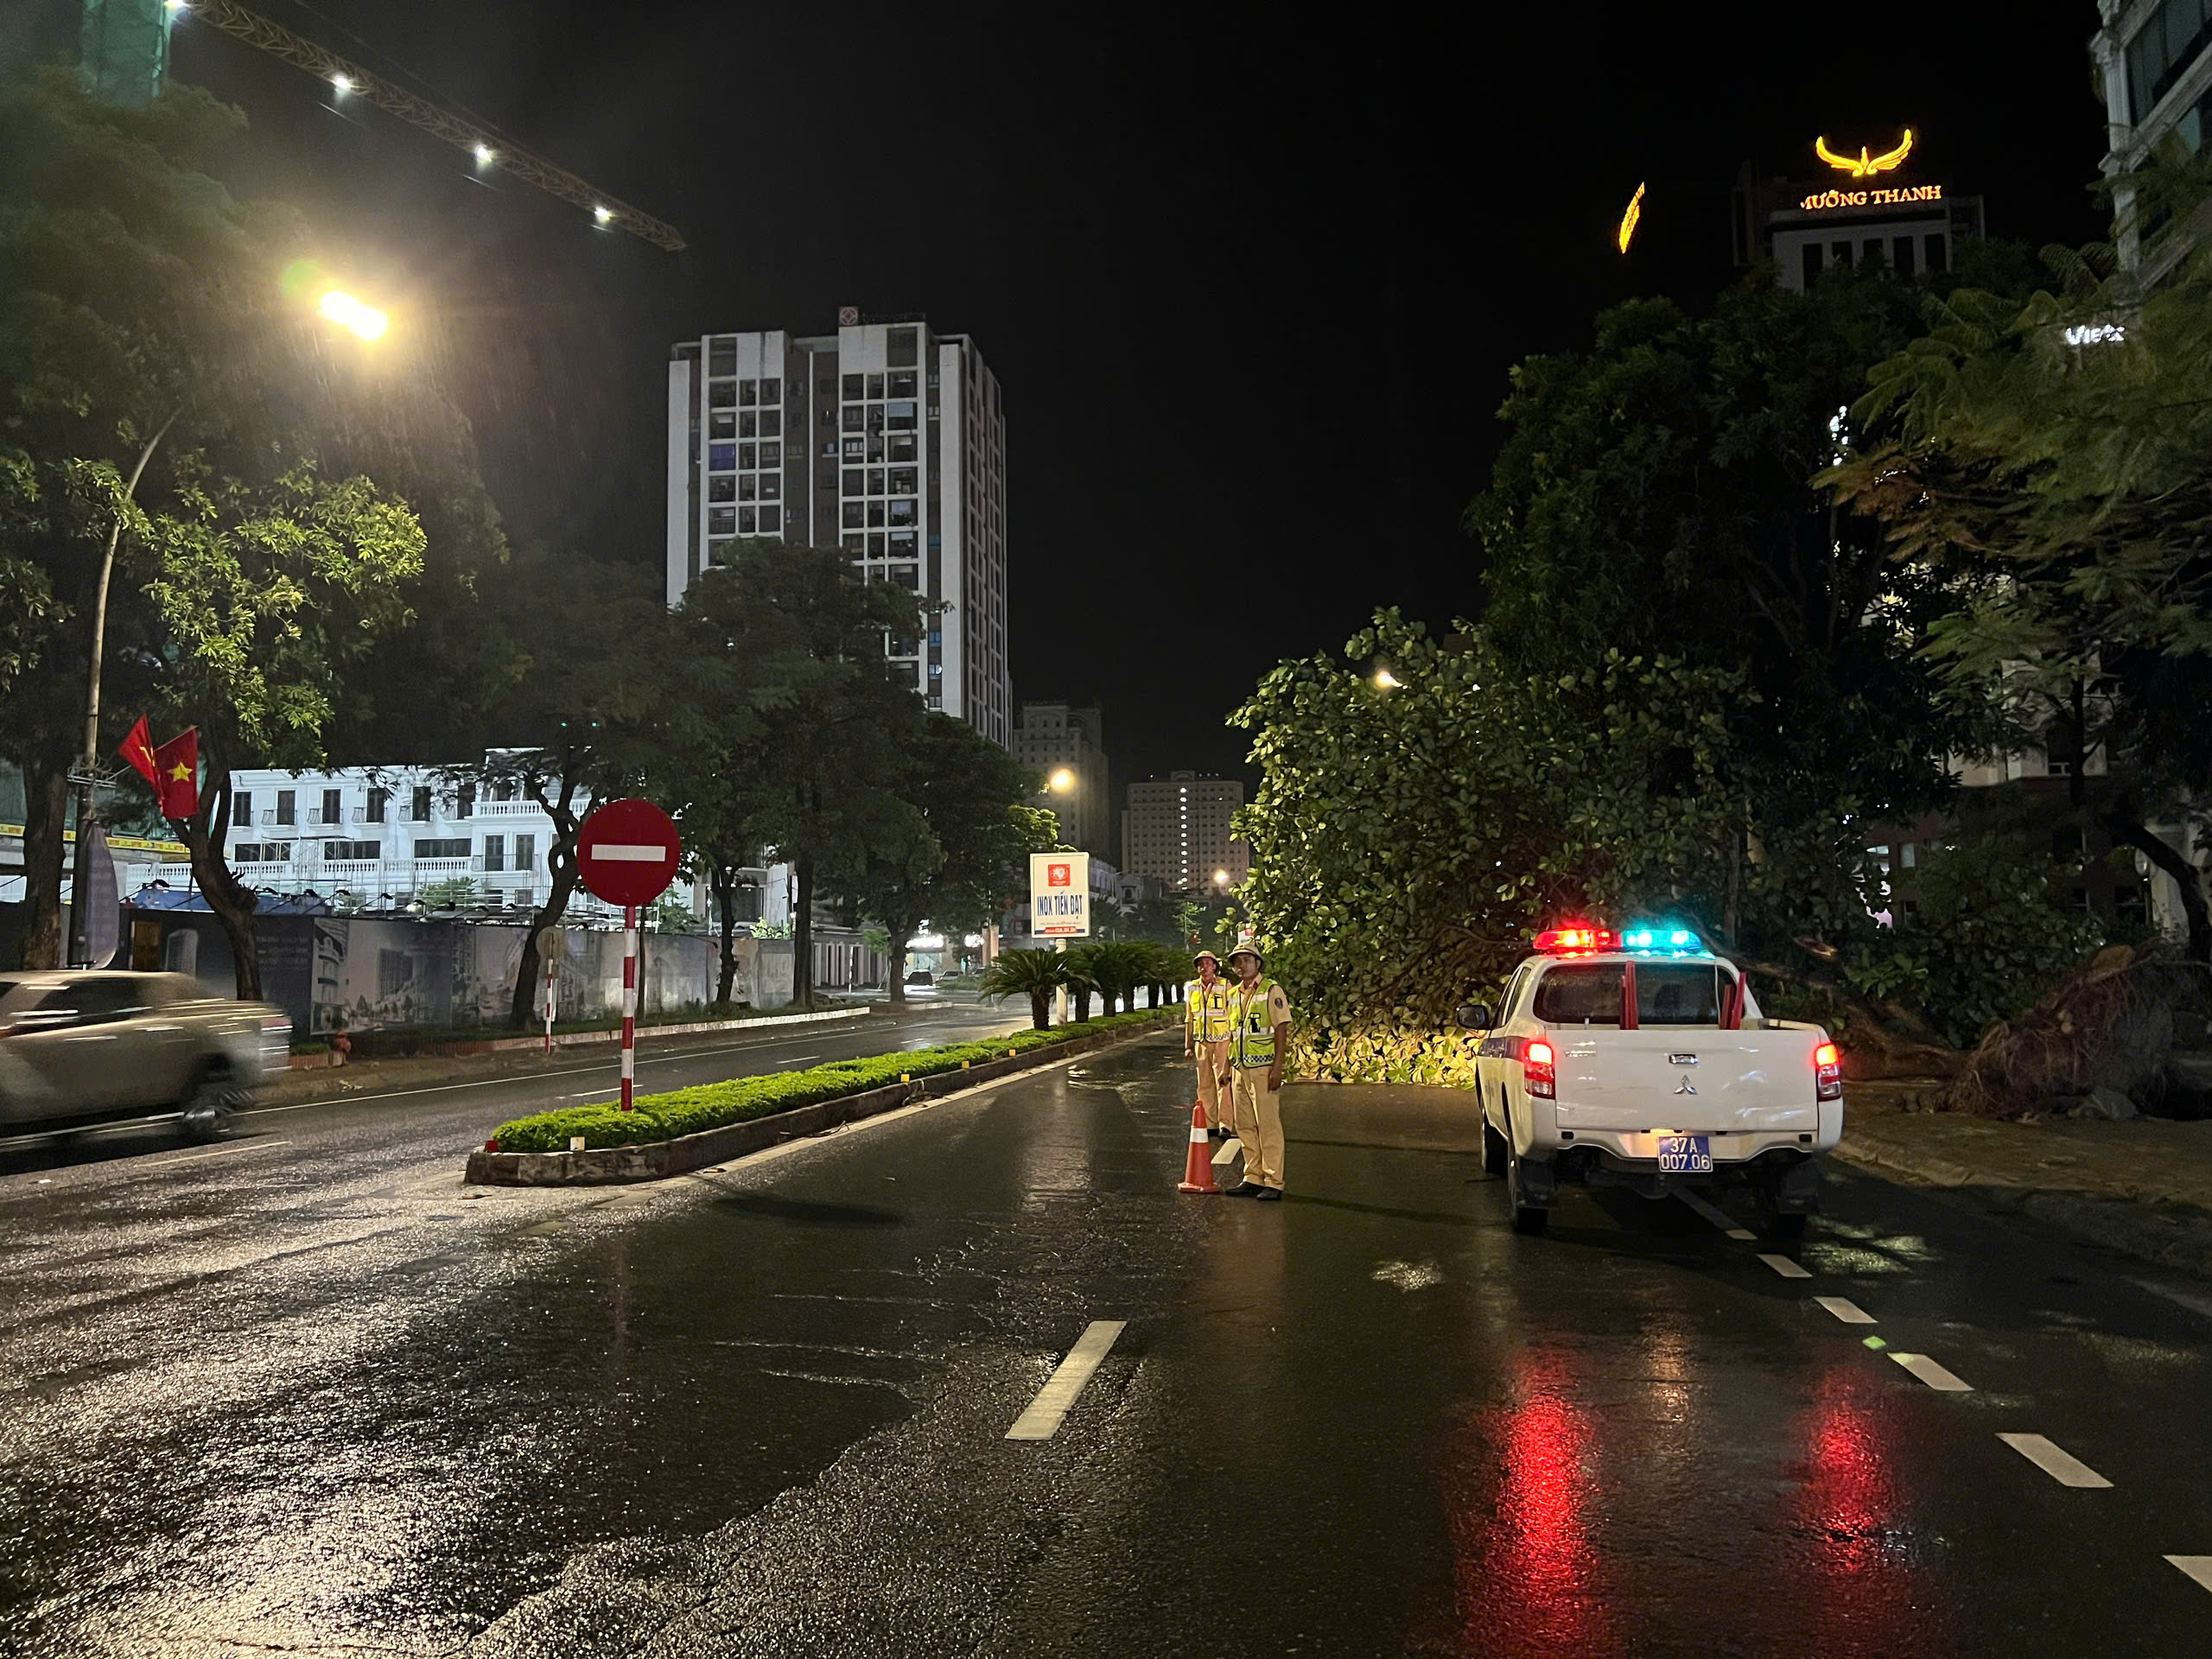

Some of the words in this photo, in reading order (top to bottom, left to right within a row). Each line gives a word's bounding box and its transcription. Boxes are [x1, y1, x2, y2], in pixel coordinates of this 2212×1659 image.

[1871, 185, 1942, 205] THANH
[1037, 895, 1052, 916] INOX
[1670, 1137, 1698, 1154] 37A
[1660, 1154, 1711, 1170] 007.06
